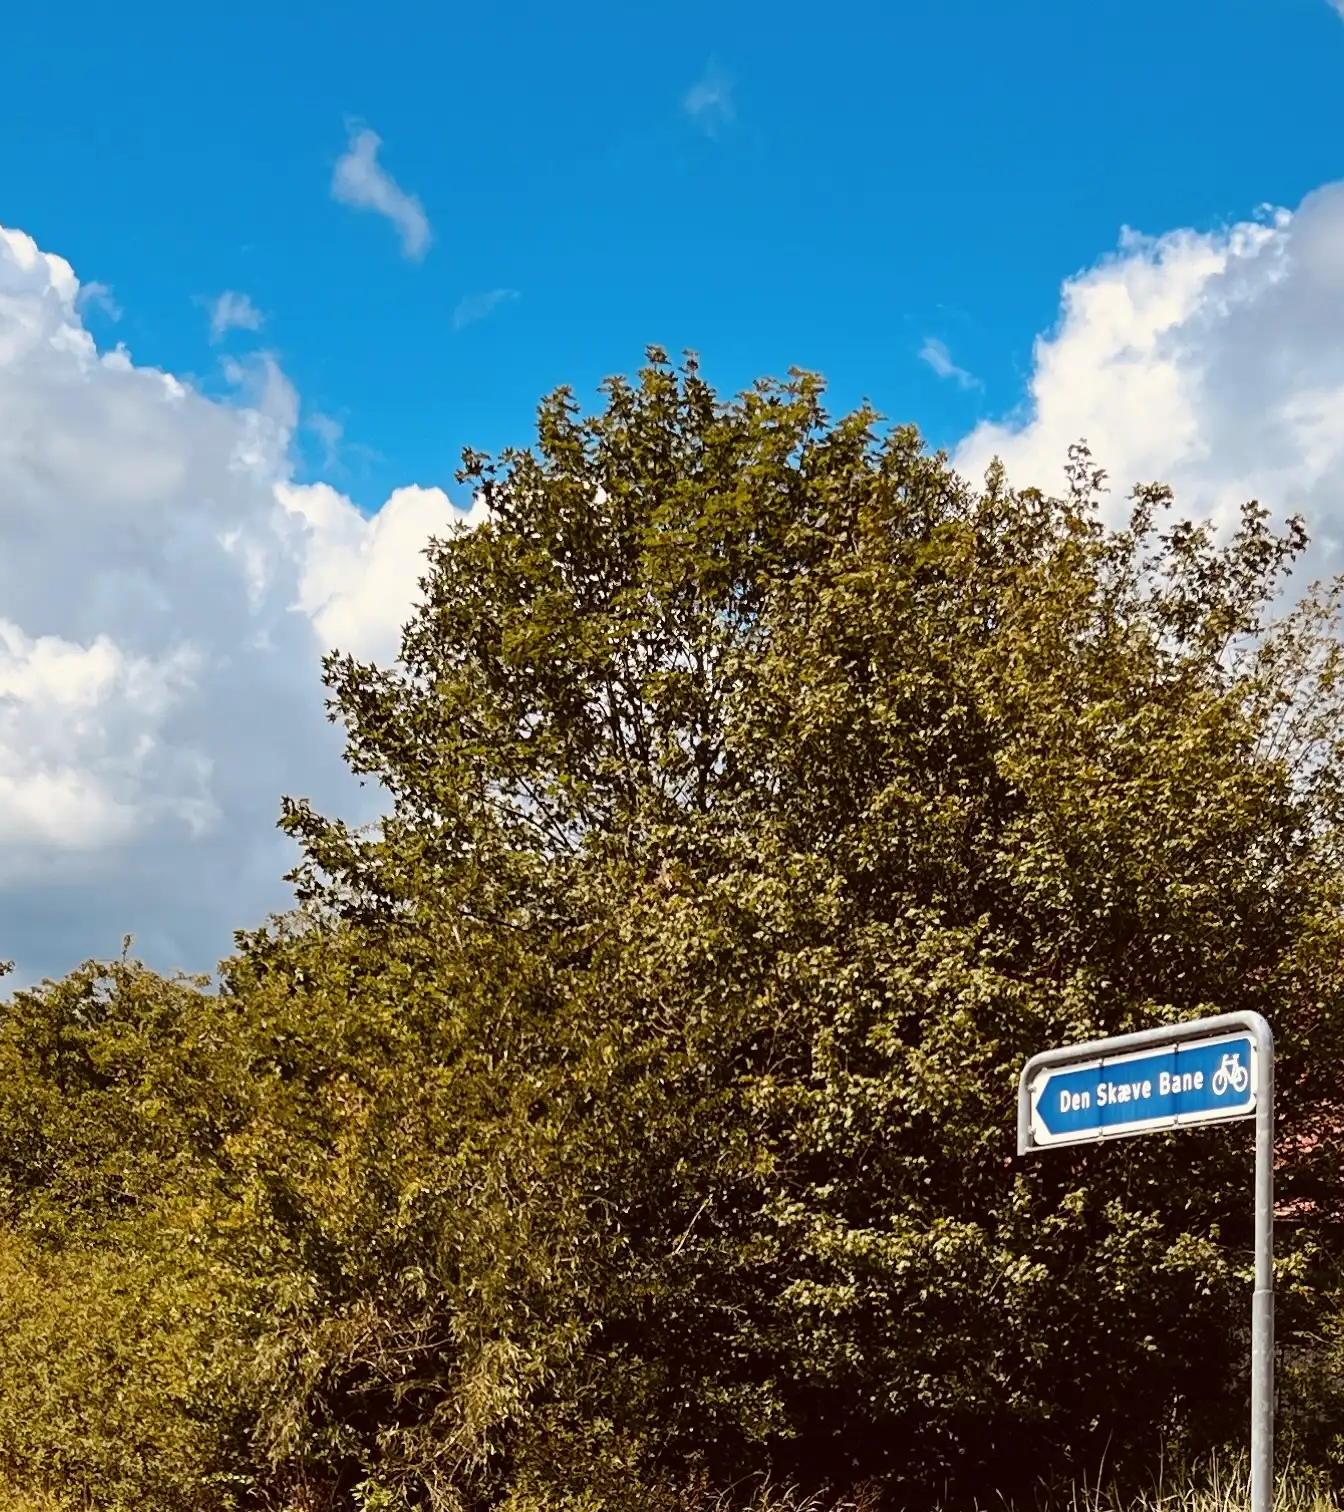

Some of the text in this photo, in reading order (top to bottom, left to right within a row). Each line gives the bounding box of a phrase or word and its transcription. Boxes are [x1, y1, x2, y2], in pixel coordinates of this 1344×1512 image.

[1060, 1070, 1204, 1113] Den Skæve Bane
